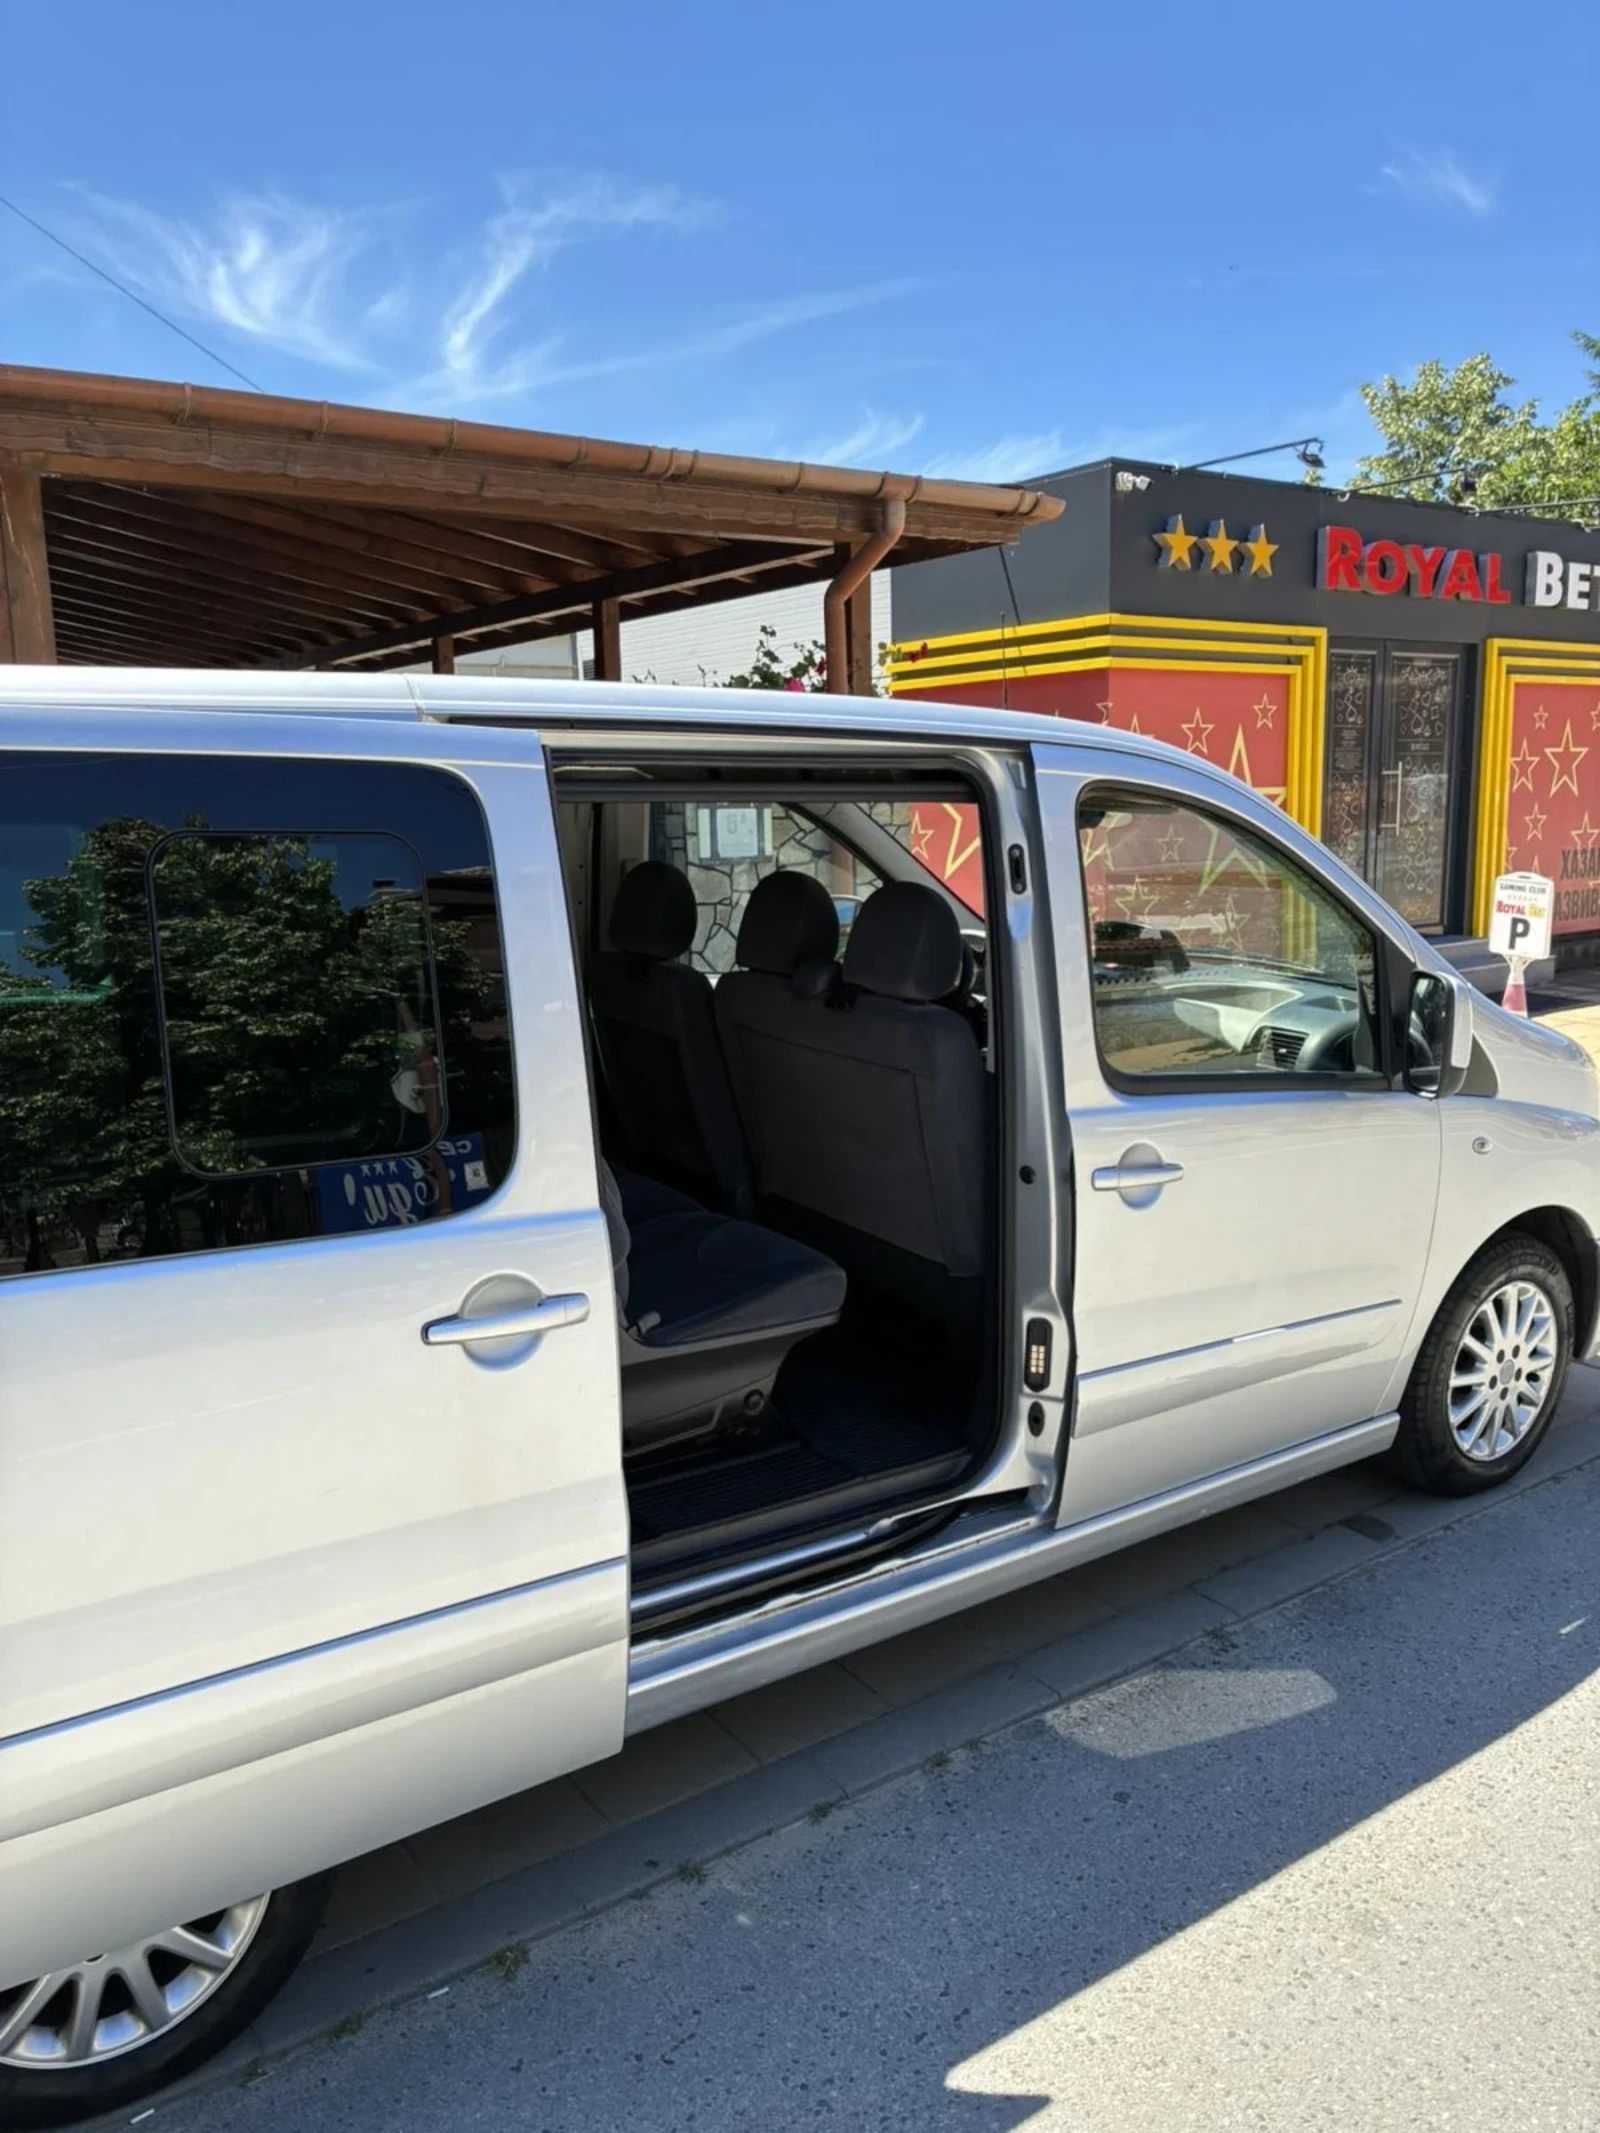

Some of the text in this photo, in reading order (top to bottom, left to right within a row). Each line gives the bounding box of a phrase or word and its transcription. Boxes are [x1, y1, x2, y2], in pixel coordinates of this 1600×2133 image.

[1320, 525, 1600, 611] ROYAL BE
[1508, 916, 1531, 950] P
